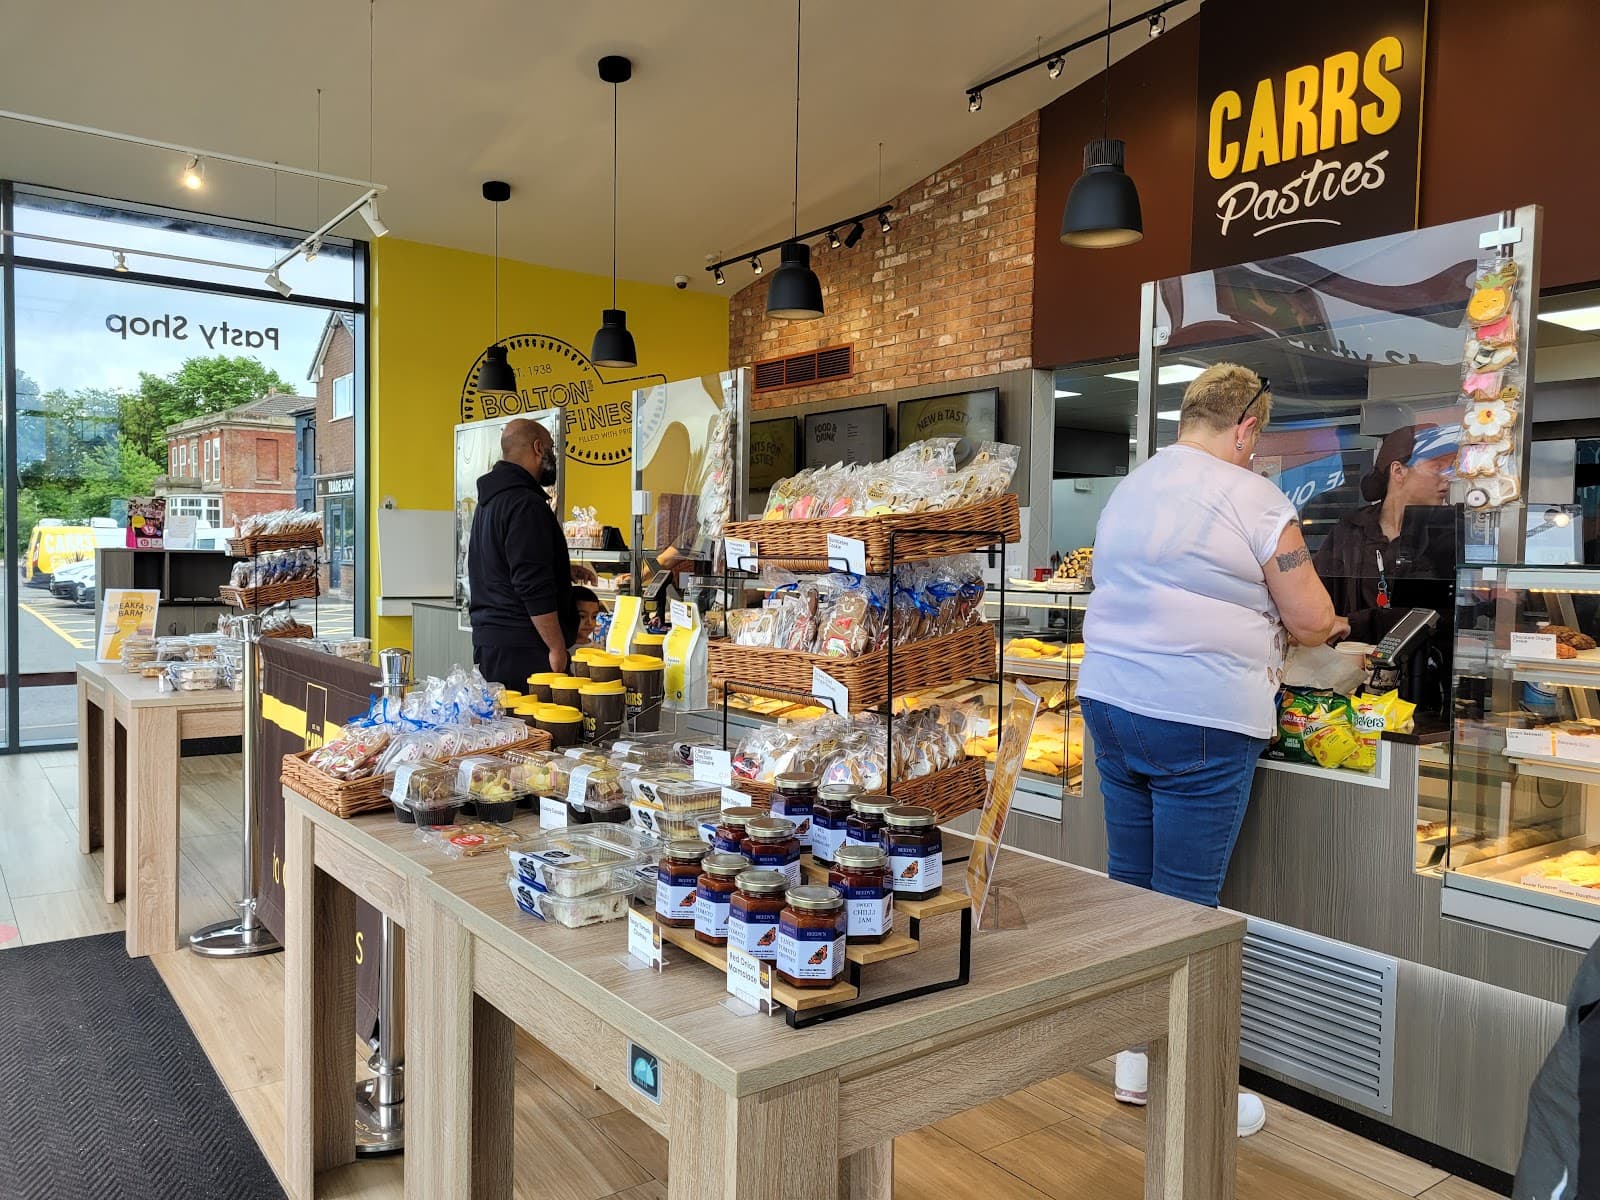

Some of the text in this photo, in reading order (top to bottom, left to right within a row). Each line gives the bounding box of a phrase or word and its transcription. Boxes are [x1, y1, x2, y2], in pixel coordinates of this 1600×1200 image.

[1208, 36, 1403, 179] CARRS
[1215, 149, 1390, 237] Pasties
[528, 363, 553, 377] 1938
[480, 381, 590, 419] BOLTON
[917, 412, 936, 432] NEW
[118, 609, 143, 617] BARM
[858, 916, 872, 924] JAM
[729, 951, 739, 962] Red
[740, 955, 757, 972] Onion
[728, 962, 758, 985] Marmalade
